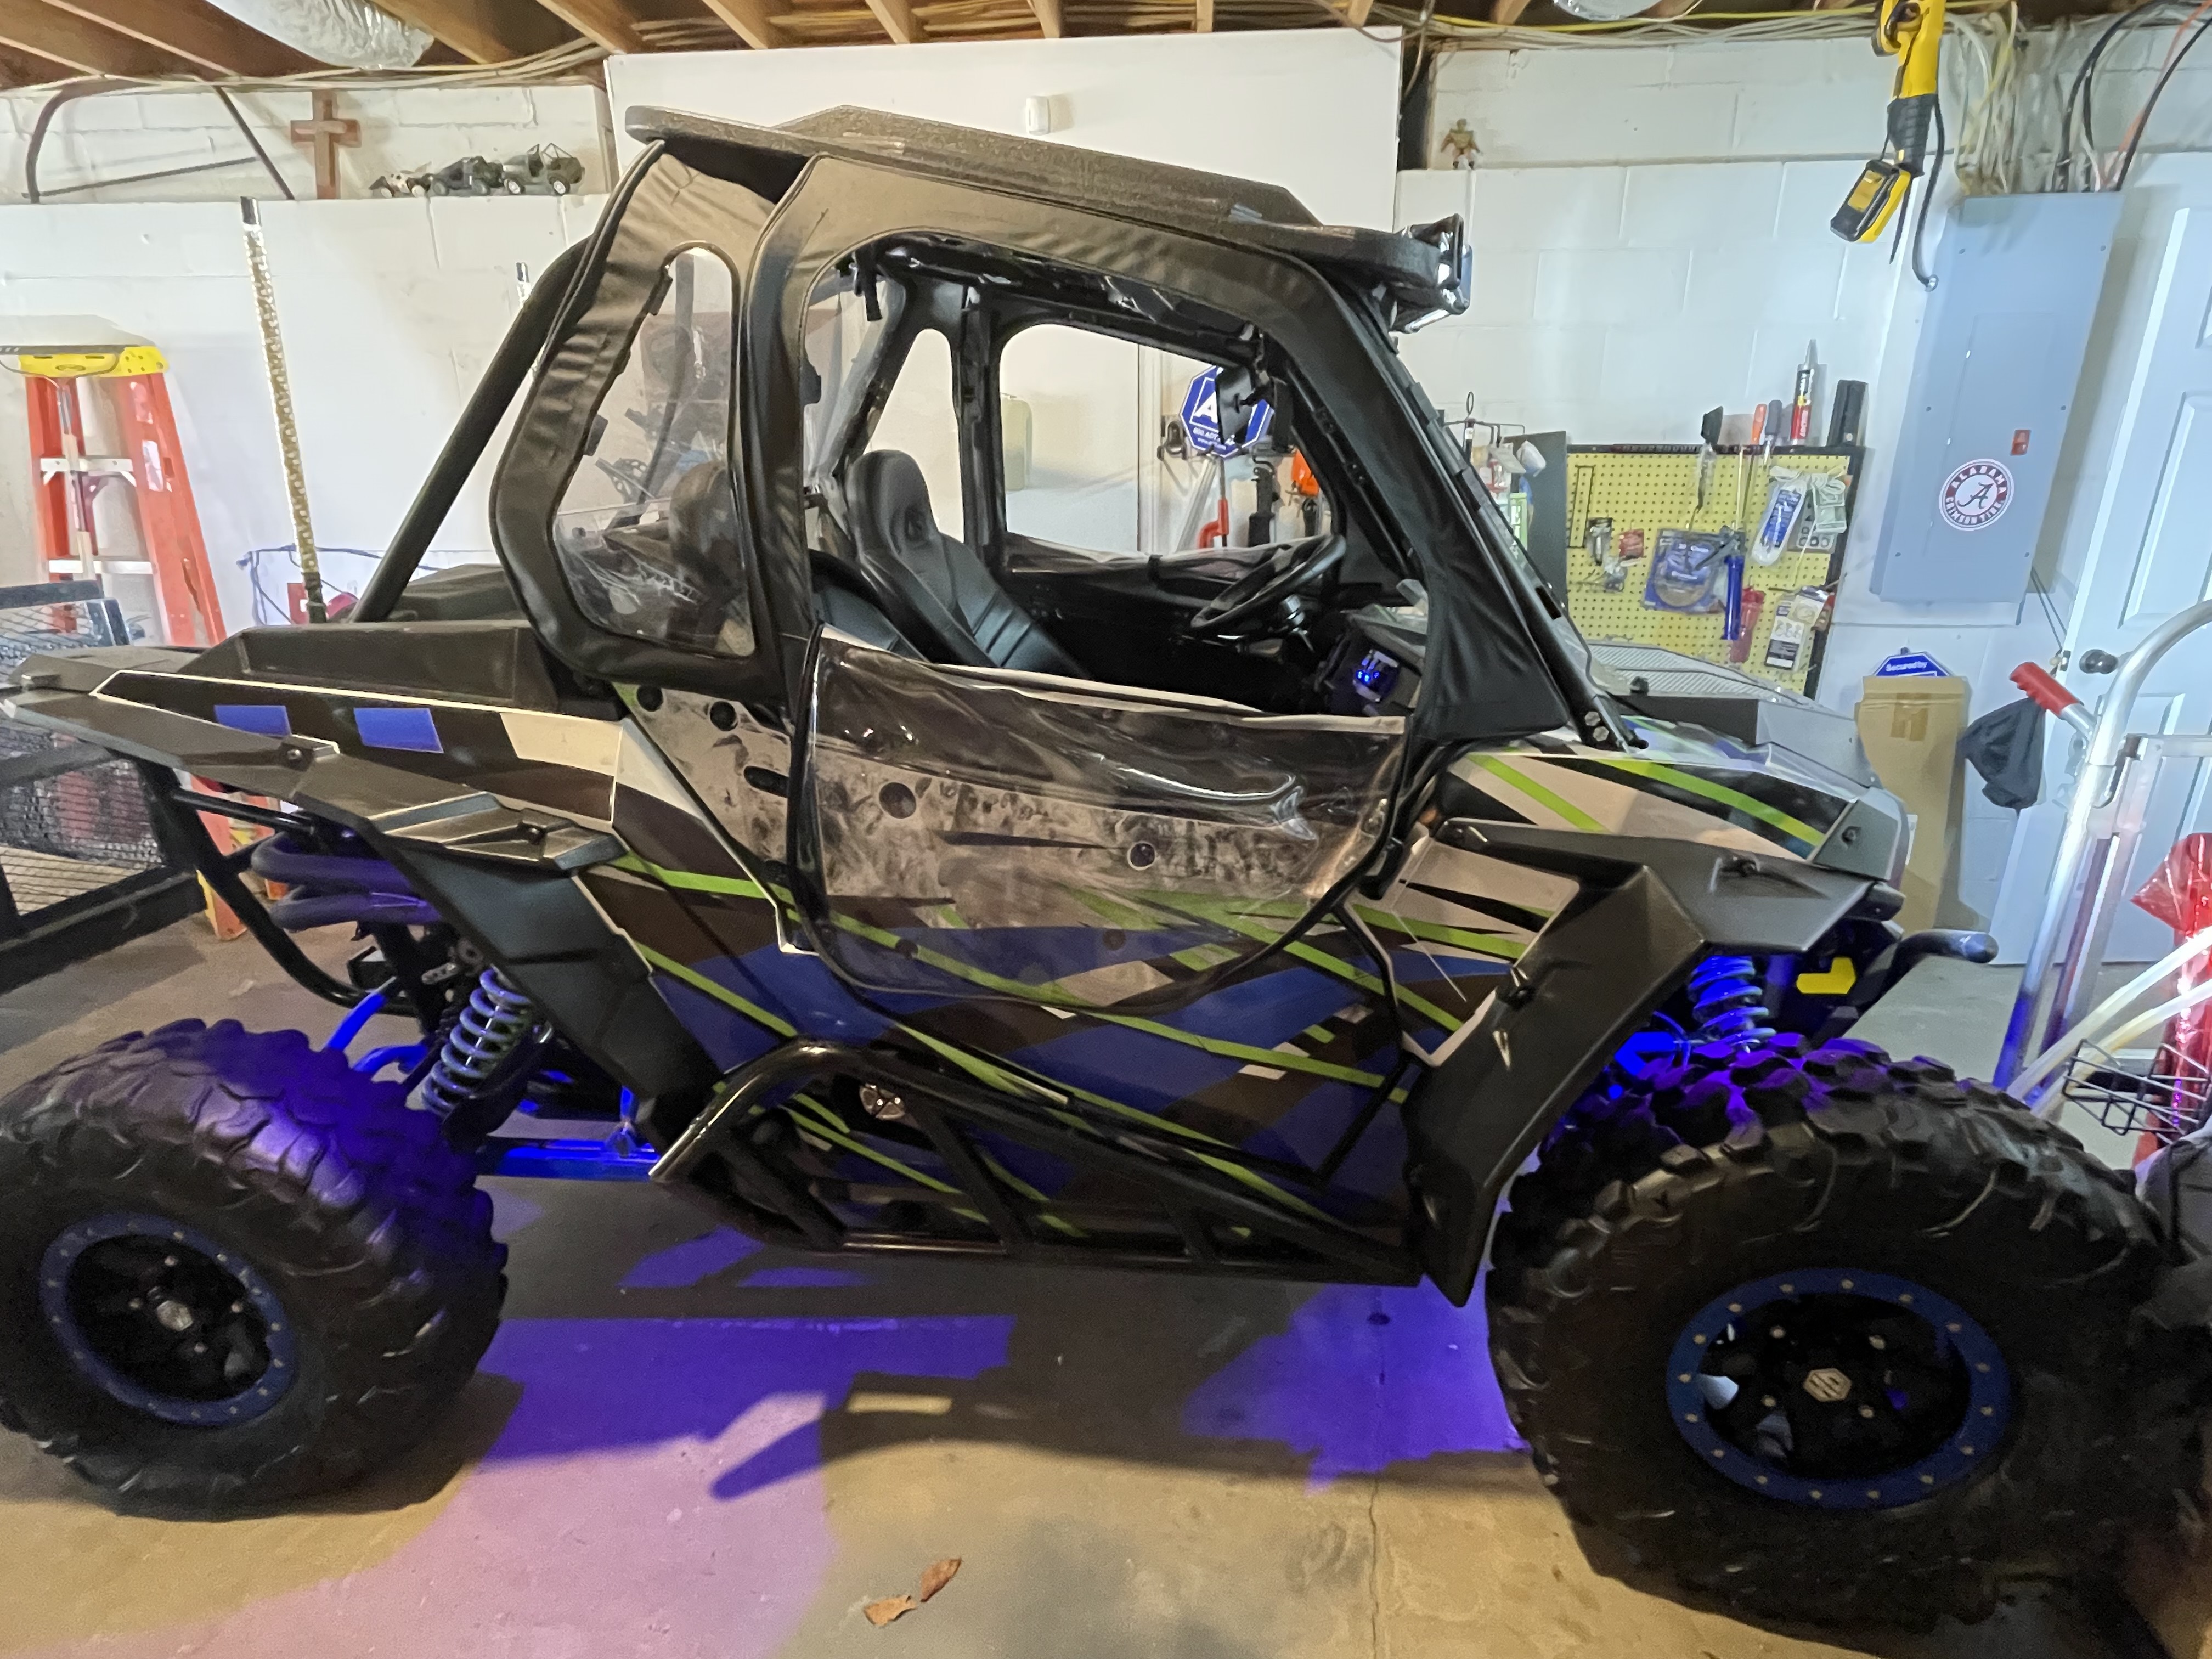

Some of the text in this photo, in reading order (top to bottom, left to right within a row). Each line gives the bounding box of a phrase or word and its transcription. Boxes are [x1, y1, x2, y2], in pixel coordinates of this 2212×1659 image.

[1951, 466, 2006, 494] ALABAMA
[1957, 482, 1994, 509] A
[1946, 497, 2002, 524] CRIMSON TIDE
[1886, 662, 1916, 671] Secured
